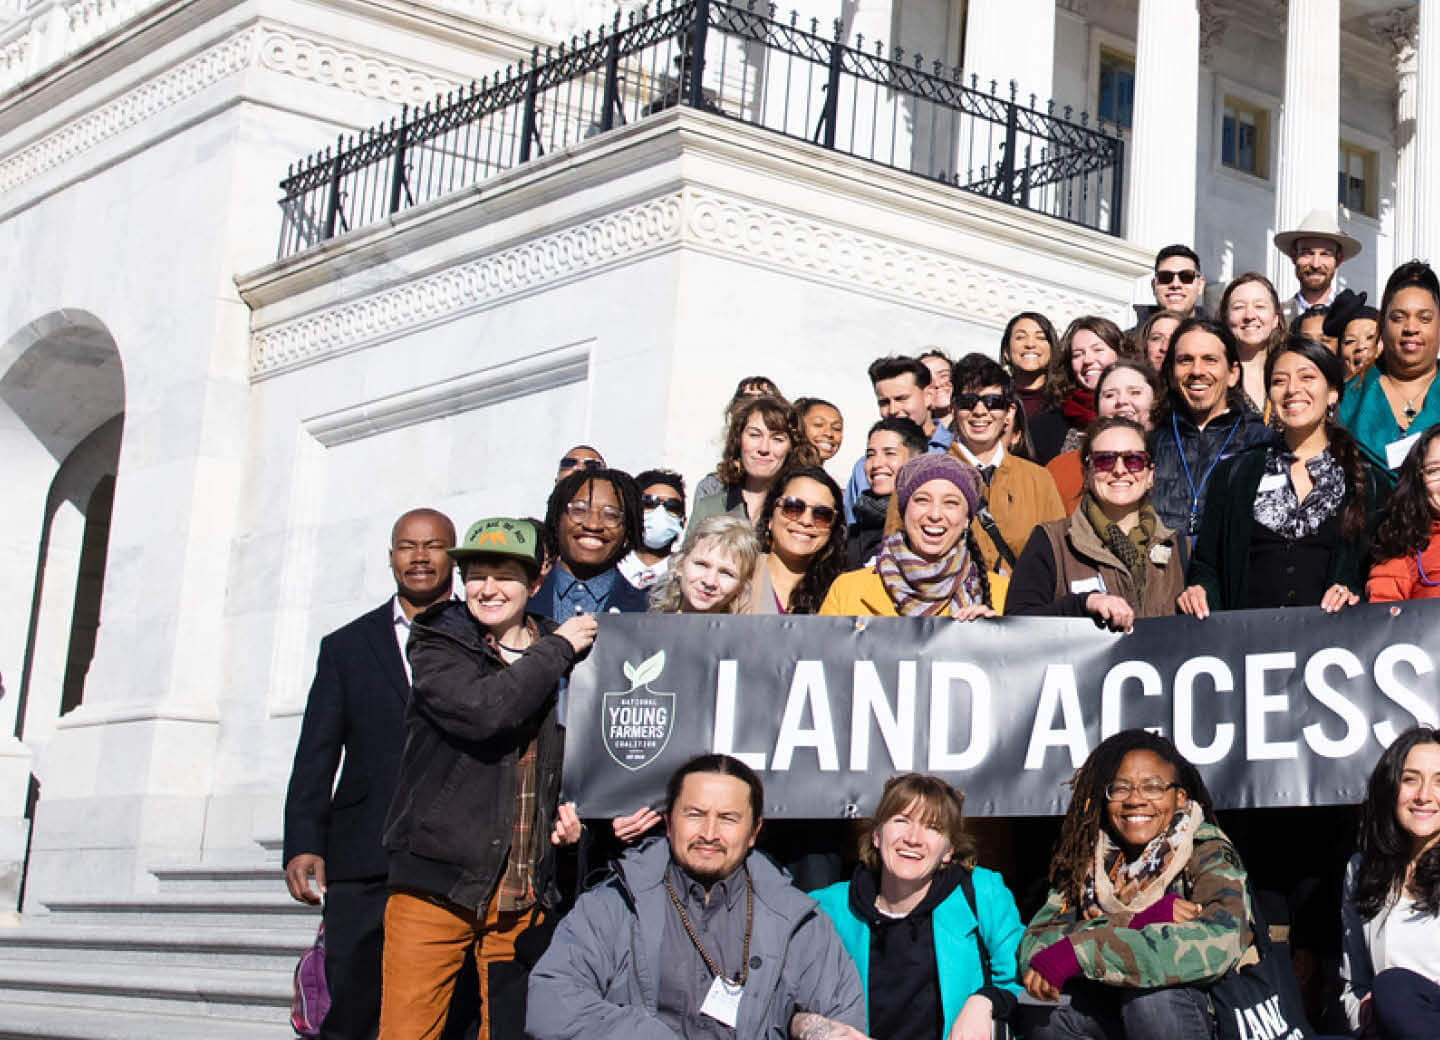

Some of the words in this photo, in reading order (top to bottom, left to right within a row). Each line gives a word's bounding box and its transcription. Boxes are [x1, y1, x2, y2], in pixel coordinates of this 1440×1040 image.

[609, 707, 667, 726] YOUNG
[712, 660, 992, 771] LAND
[1024, 643, 1440, 770] ACCESS
[610, 726, 665, 738] FARMERS
